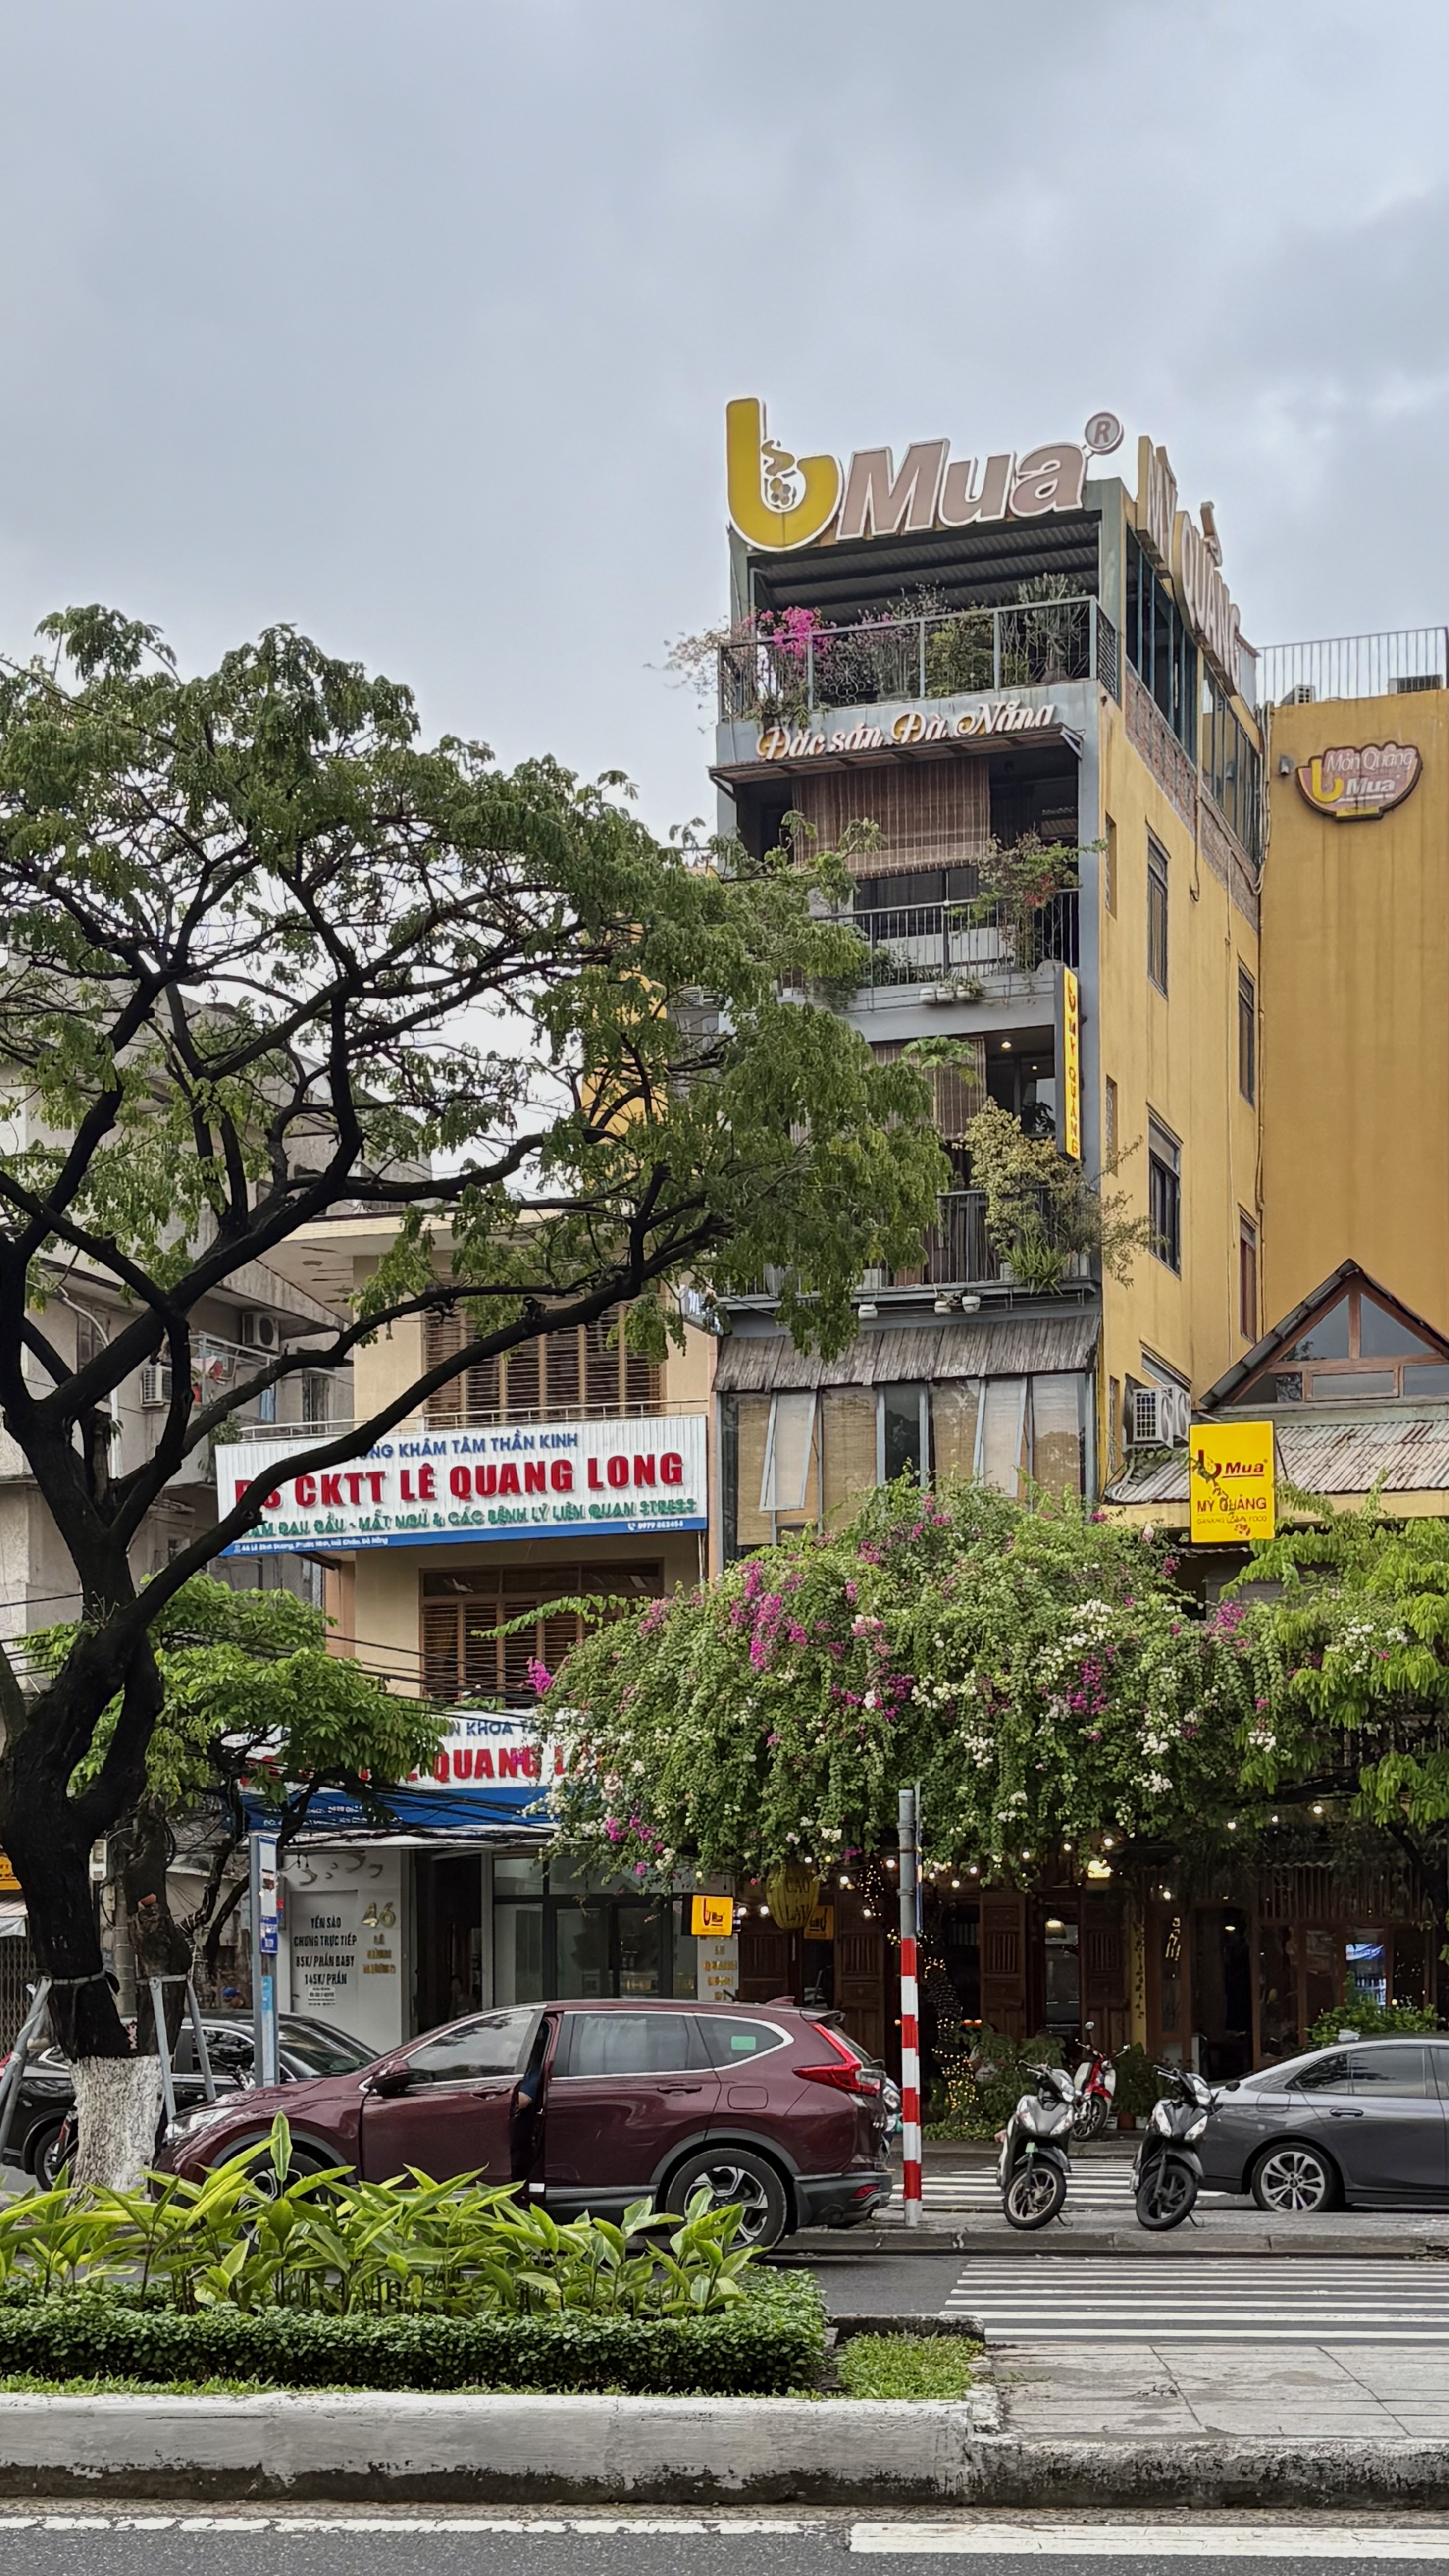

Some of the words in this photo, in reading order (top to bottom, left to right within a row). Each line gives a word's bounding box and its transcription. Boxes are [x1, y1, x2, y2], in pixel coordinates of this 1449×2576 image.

[835, 438, 1087, 541] Mua
[891, 711, 948, 744] Đà
[1346, 777, 1395, 795] Mua
[452, 1436, 486, 1454] TÂM
[491, 1429, 534, 1452] THẦN
[540, 1433, 578, 1449] KINH
[401, 1463, 435, 1501] LÊ
[450, 1459, 574, 1501] QUANG
[588, 1453, 683, 1490] LONG
[1225, 1462, 1264, 1474] Mua
[433, 1513, 445, 1527] &
[588, 1502, 636, 1519] QUAN
[640, 1498, 696, 1516] STRESS
[466, 1721, 514, 1736] KHOA
[362, 1902, 396, 1928] 46
